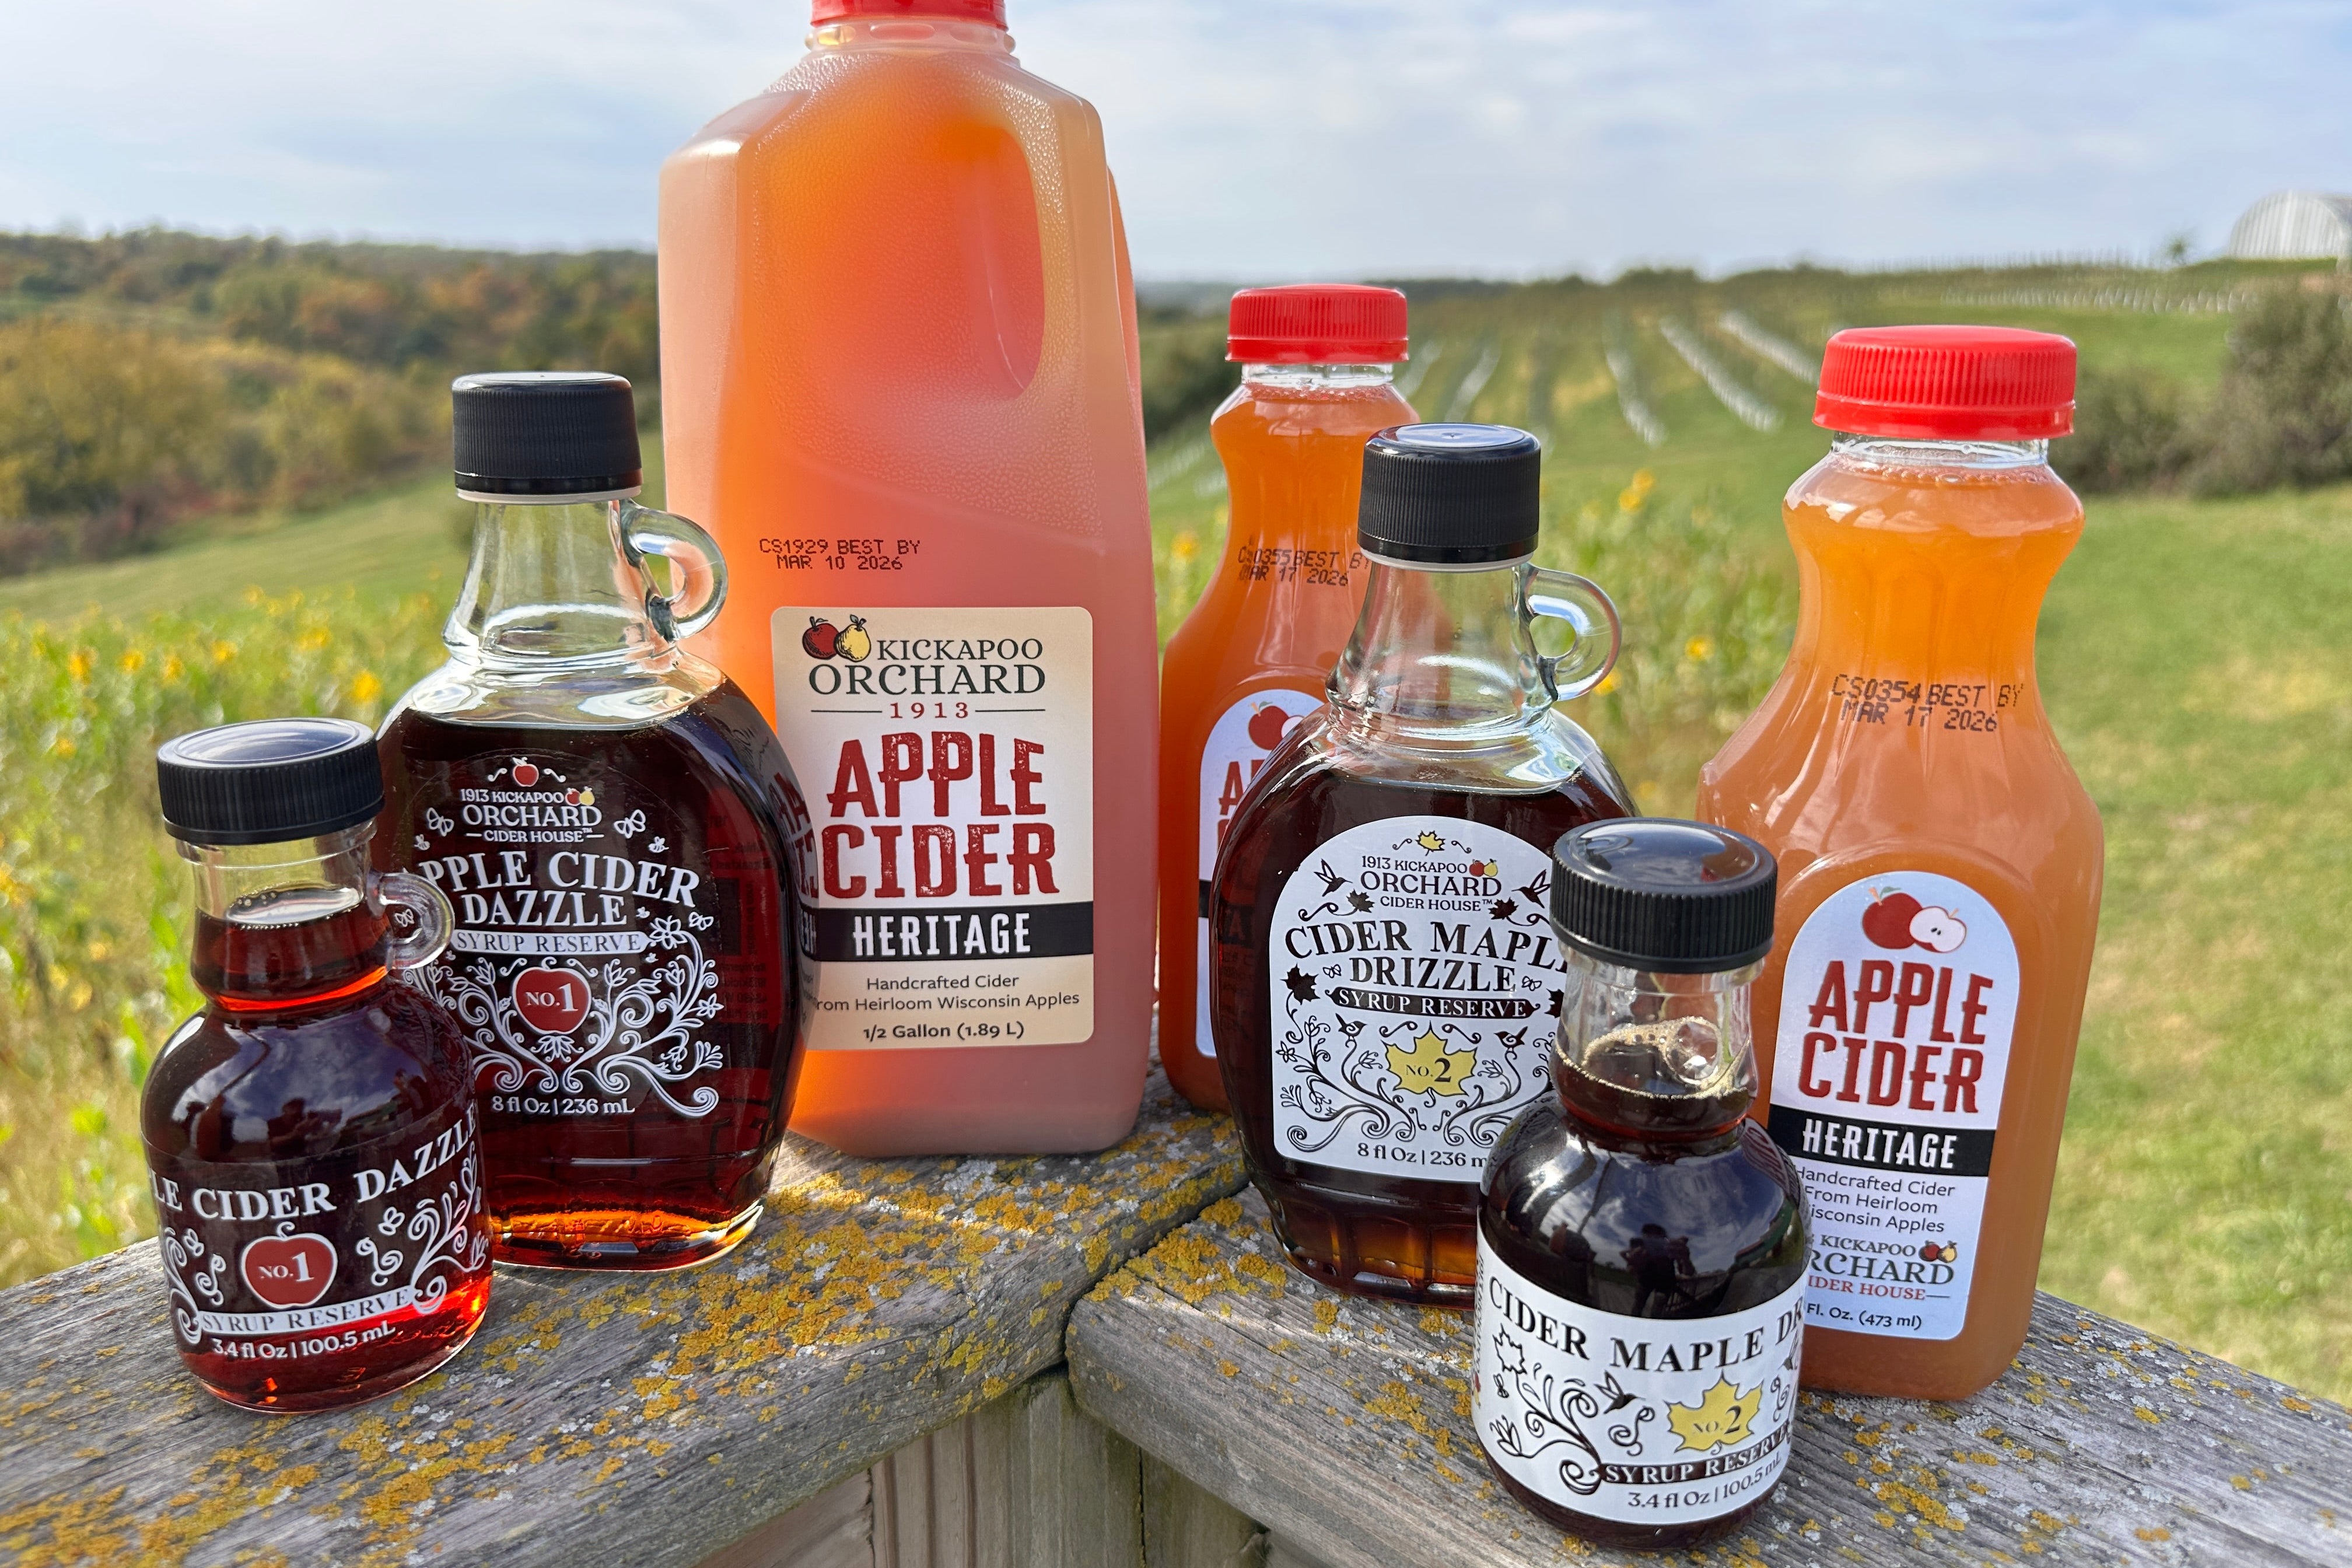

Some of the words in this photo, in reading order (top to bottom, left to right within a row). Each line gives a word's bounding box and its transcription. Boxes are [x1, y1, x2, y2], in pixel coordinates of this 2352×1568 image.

[760, 539, 828, 554] CS1929
[838, 540, 884, 554] BEST
[897, 540, 921, 554] BY
[1293, 550, 1339, 568] BEST
[777, 556, 813, 569] MAR
[825, 556, 845, 569] 10
[858, 556, 903, 570] 2026
[1239, 564, 1269, 581] MAR
[1279, 566, 1297, 582] 17
[1306, 568, 1349, 586] 2026
[877, 639, 1043, 660] KICKAPOO
[809, 664, 1045, 695] ORCHARD
[1832, 674, 1921, 702] CS0354
[1926, 684, 1986, 707] BEST
[1997, 683, 2024, 707] BY
[890, 702, 968, 719] 1913
[1840, 699, 1889, 725] MAR
[1905, 705, 1932, 727] 17
[1944, 709, 1998, 732] 2026
[827, 731, 1046, 817] APPLE
[461, 789, 489, 802] 1913
[492, 792, 564, 804] KICKAPOO
[463, 805, 602, 827] ORCHARD
[484, 830, 528, 842] CIDER
[821, 823, 1059, 898] CIDER
[1362, 856, 1391, 870] 1913
[1394, 860, 1467, 873] KICKAPOO
[416, 850, 531, 892] PPLE
[549, 851, 700, 908] CIDER
[1361, 871, 1502, 897] ORCHARD
[460, 890, 627, 926] DAZZLE
[1380, 897, 1424, 909] CIDER
[457, 932, 524, 951] SYRUP
[537, 935, 640, 953] RESERVE
[853, 912, 1031, 957] HERITAGE
[1285, 919, 1412, 958] CIDER
[1430, 922, 1567, 974] MAPL
[867, 975, 969, 991] Handcrafted
[975, 974, 1019, 989] Cider
[1349, 957, 1516, 992] DRIZZLE
[527, 991, 560, 1008] NO.
[559, 983, 578, 1012] 1
[816, 1000, 849, 1011] rom
[856, 995, 932, 1011] Heirloom
[938, 993, 1021, 1009] Wisconsin
[1026, 992, 1079, 1009] Apples
[1339, 990, 1410, 1012] SYRUP
[1421, 999, 1526, 1017] RESERVE
[1808, 960, 1993, 1044] APPLE
[863, 1024, 887, 1042] 1/2
[892, 1023, 951, 1038] Gallon
[957, 1021, 1000, 1040] (1.89
[1007, 1020, 1024, 1039] L)
[1406, 1065, 1433, 1077] NO.
[1434, 1058, 1451, 1083] 2
[1798, 1032, 1984, 1113] CIDER
[492, 1096, 503, 1111] 8
[506, 1096, 523, 1113] fl
[524, 1098, 551, 1114] Oz
[562, 1097, 598, 1114] 236
[604, 1098, 635, 1114] mL
[1357, 1143, 1368, 1157] 8
[1371, 1144, 1387, 1160] fl
[1391, 1147, 1416, 1163] Oz
[1430, 1152, 1466, 1166] 236
[1803, 1118, 1958, 1169] HERITAGE
[191, 1182, 337, 1221] CIDER
[354, 1101, 476, 1203] DAZZLE
[1908, 1181, 1955, 1196] Cider
[1856, 1194, 1937, 1213] Heirloom
[1811, 1204, 1880, 1227] isconsin
[1885, 1216, 1944, 1234] Apples
[1820, 1234, 1916, 1256] KICKAPOO
[291, 1251, 314, 1282] 1
[1810, 1250, 1954, 1284] RCHARD
[1808, 1275, 1853, 1293] IDER
[1859, 1282, 1925, 1300] HOUSE
[203, 1314, 275, 1332] SYRUP
[288, 1288, 409, 1328] RESERVE
[1807, 1303, 1824, 1315] Fl.
[1829, 1307, 1853, 1321] Oz.
[1859, 1310, 1891, 1327] (473
[1897, 1314, 1922, 1329] ml)
[1489, 1276, 1590, 1361] CIDER
[1610, 1326, 1764, 1373] MAPLE
[213, 1339, 238, 1358] 3.4
[241, 1342, 254, 1358] fl
[261, 1343, 288, 1359] Oz
[302, 1332, 356, 1356] 100.5
[362, 1320, 396, 1342] mL
[1724, 1406, 1742, 1435] 2
[1605, 1463, 1694, 1483] SYRUP
[1628, 1492, 1658, 1508] 3.4
[1664, 1492, 1678, 1507] fl
[1684, 1489, 1710, 1506] Oz
[1723, 1469, 1763, 1499] 100.5
[1765, 1455, 1780, 1478] mL
